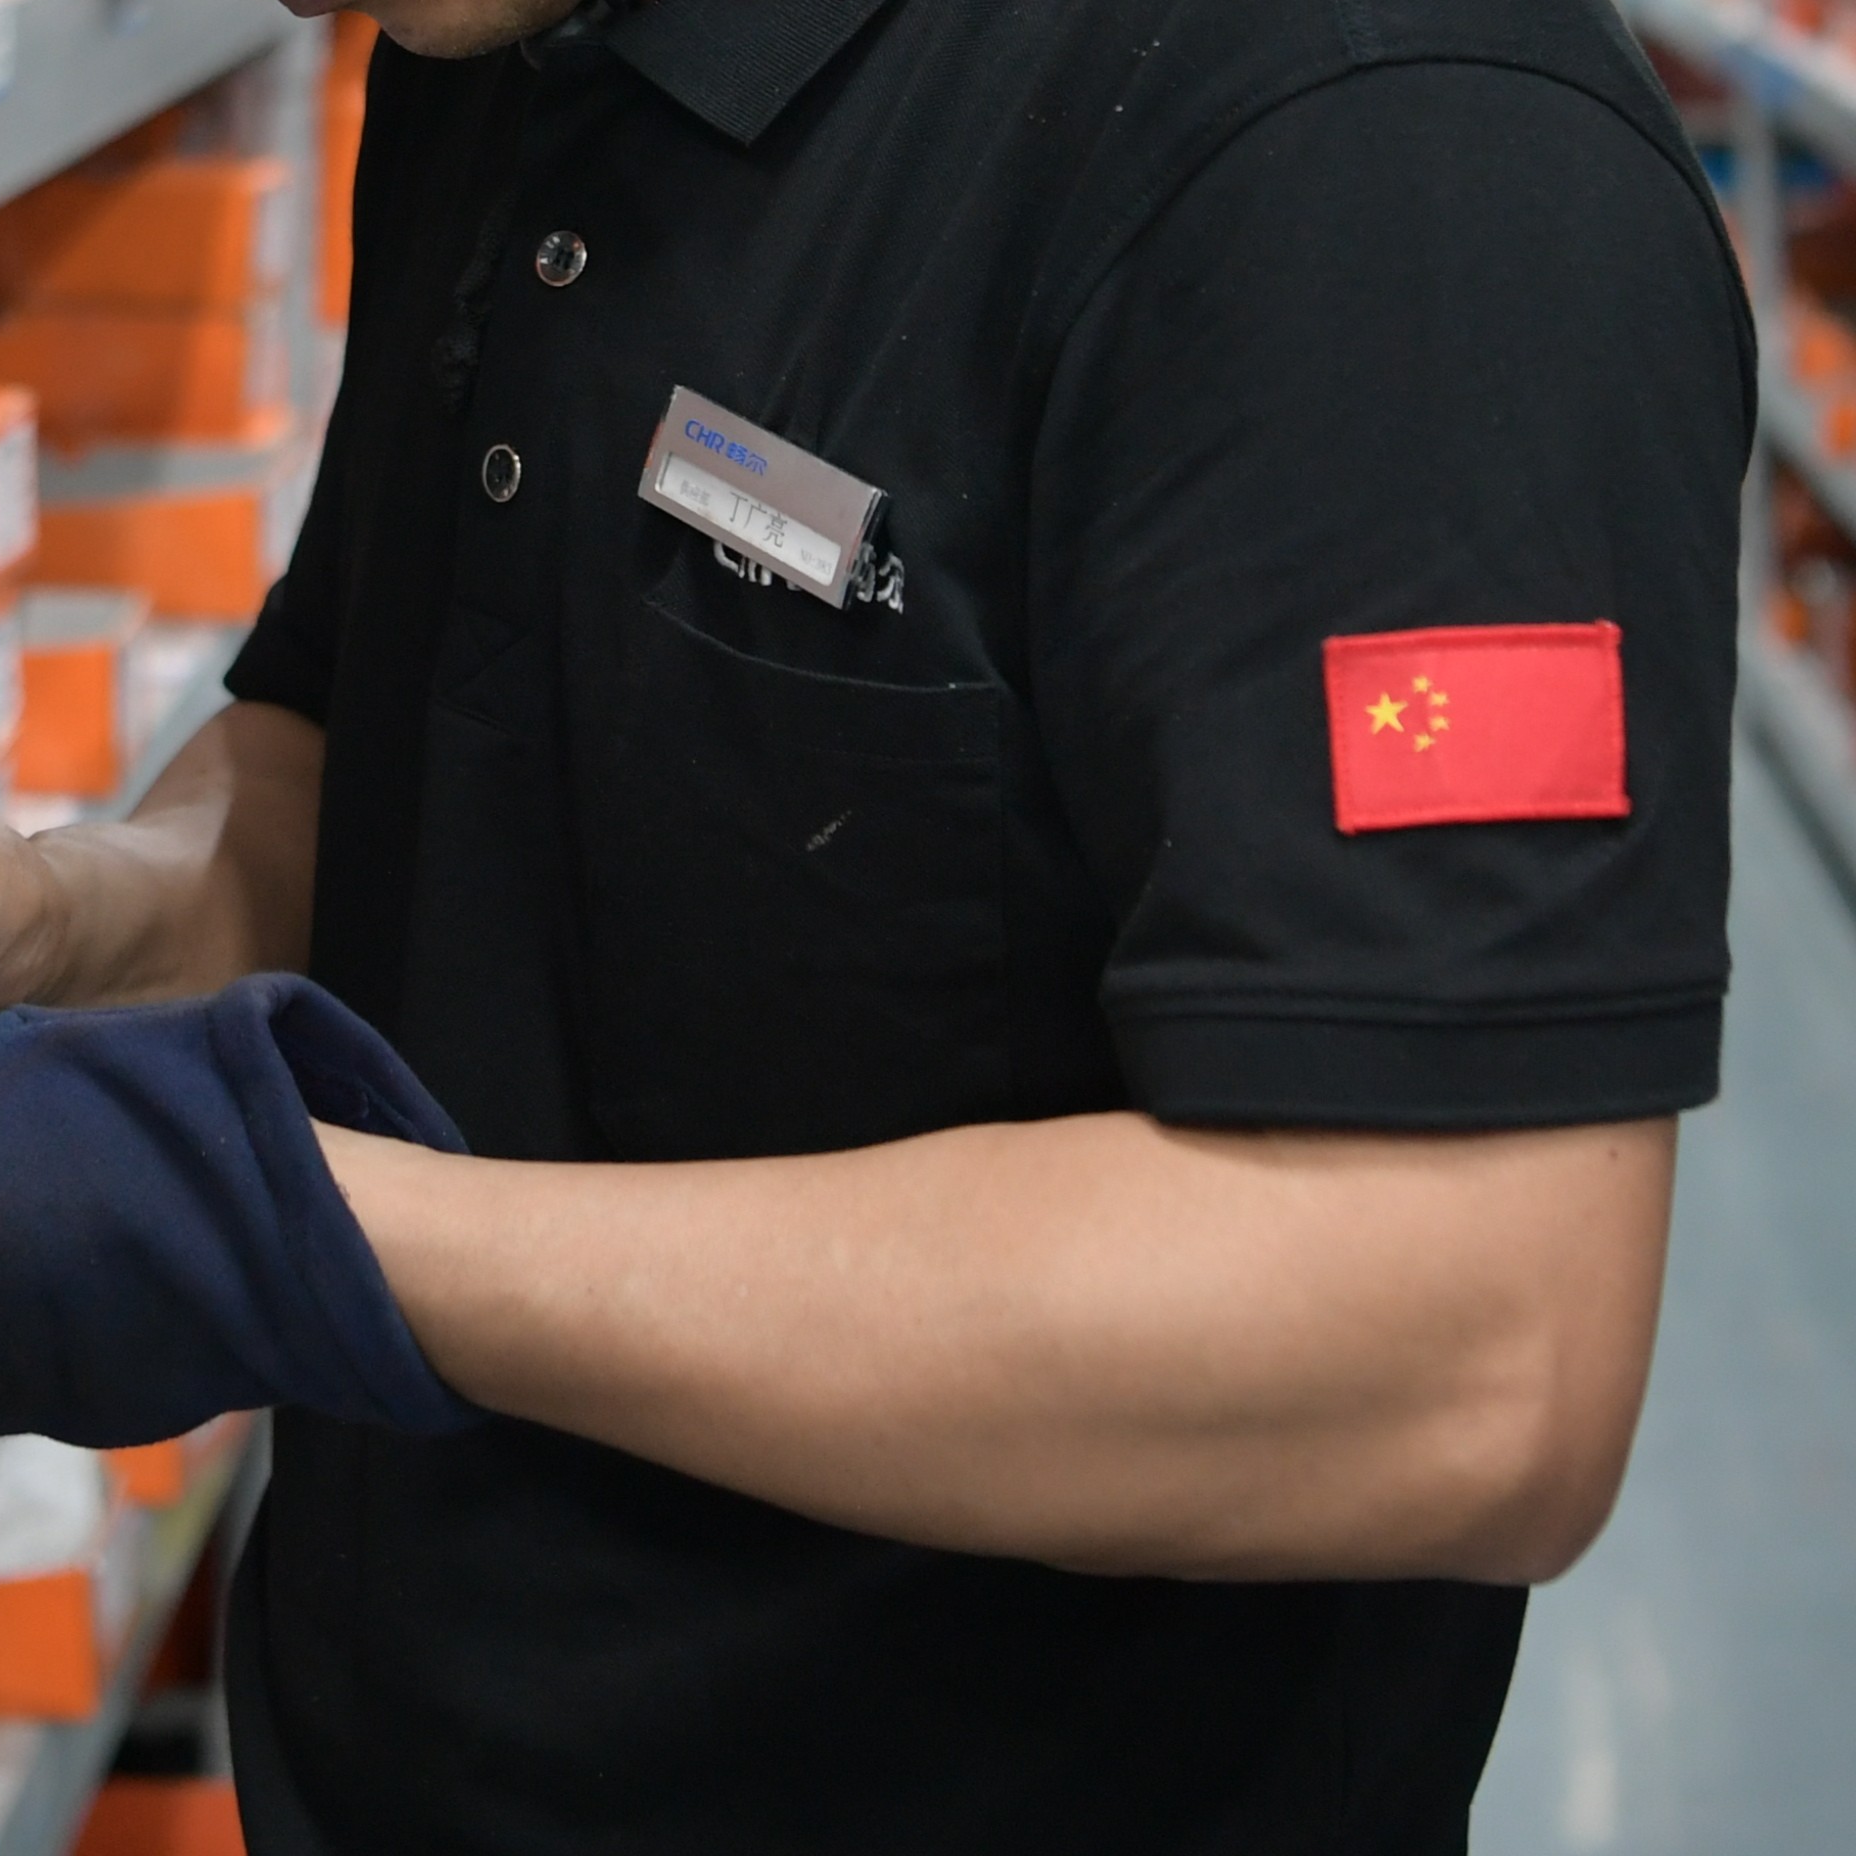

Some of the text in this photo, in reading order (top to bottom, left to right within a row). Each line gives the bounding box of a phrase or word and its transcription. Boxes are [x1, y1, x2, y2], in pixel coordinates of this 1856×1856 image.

[684, 419, 725, 456] CHR
[727, 490, 789, 549] 丁广亮
